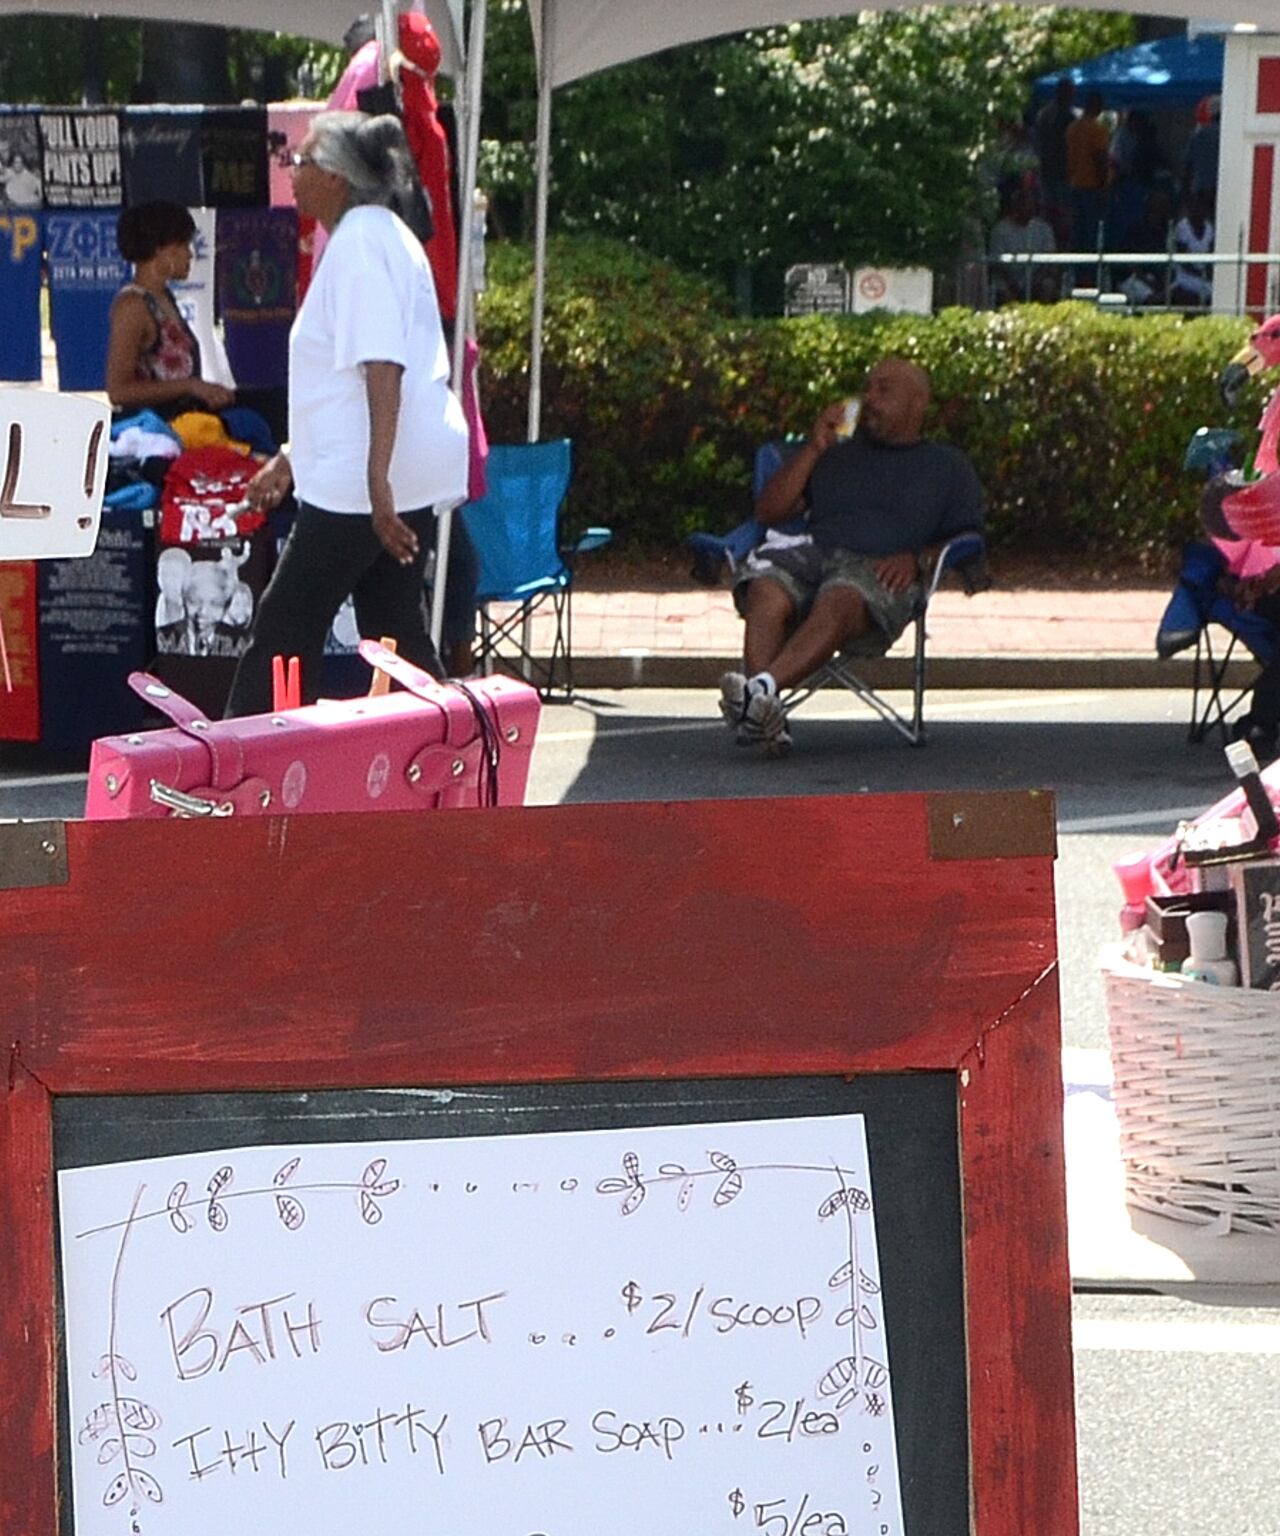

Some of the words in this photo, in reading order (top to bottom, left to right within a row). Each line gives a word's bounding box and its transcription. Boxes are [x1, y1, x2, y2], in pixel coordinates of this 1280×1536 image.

[160, 1288, 322, 1380] BATH
[365, 1292, 507, 1352] SALT
[480, 1418, 572, 1463] BAR
